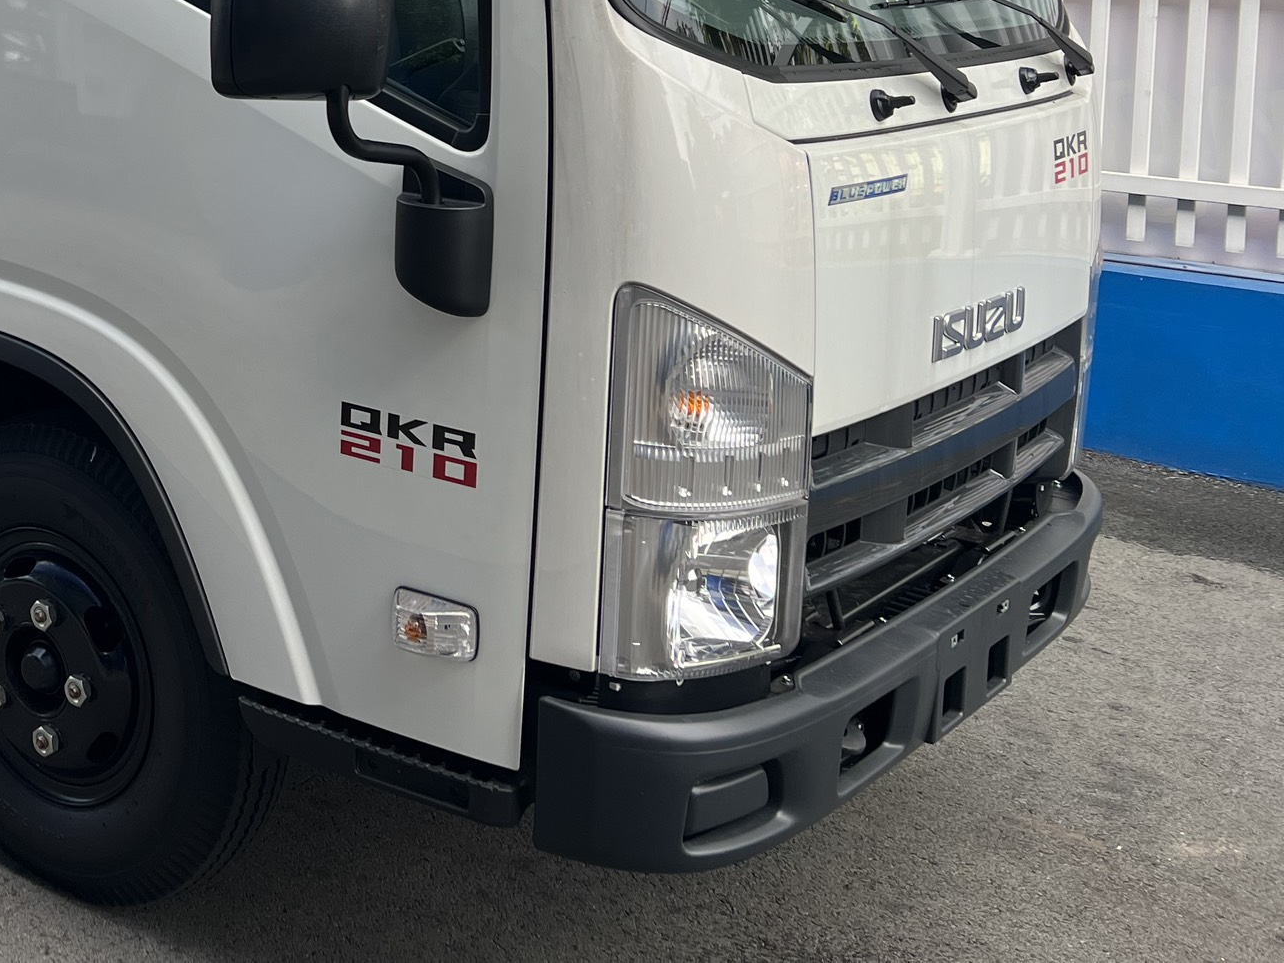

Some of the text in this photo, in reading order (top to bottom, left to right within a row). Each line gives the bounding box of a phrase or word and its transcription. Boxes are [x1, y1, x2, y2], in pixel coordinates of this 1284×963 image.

[1054, 130, 1087, 161] QKR
[1055, 152, 1088, 184] 210
[932, 286, 1025, 363] ISUZU
[340, 401, 477, 459] QKR
[340, 429, 477, 488] 210
